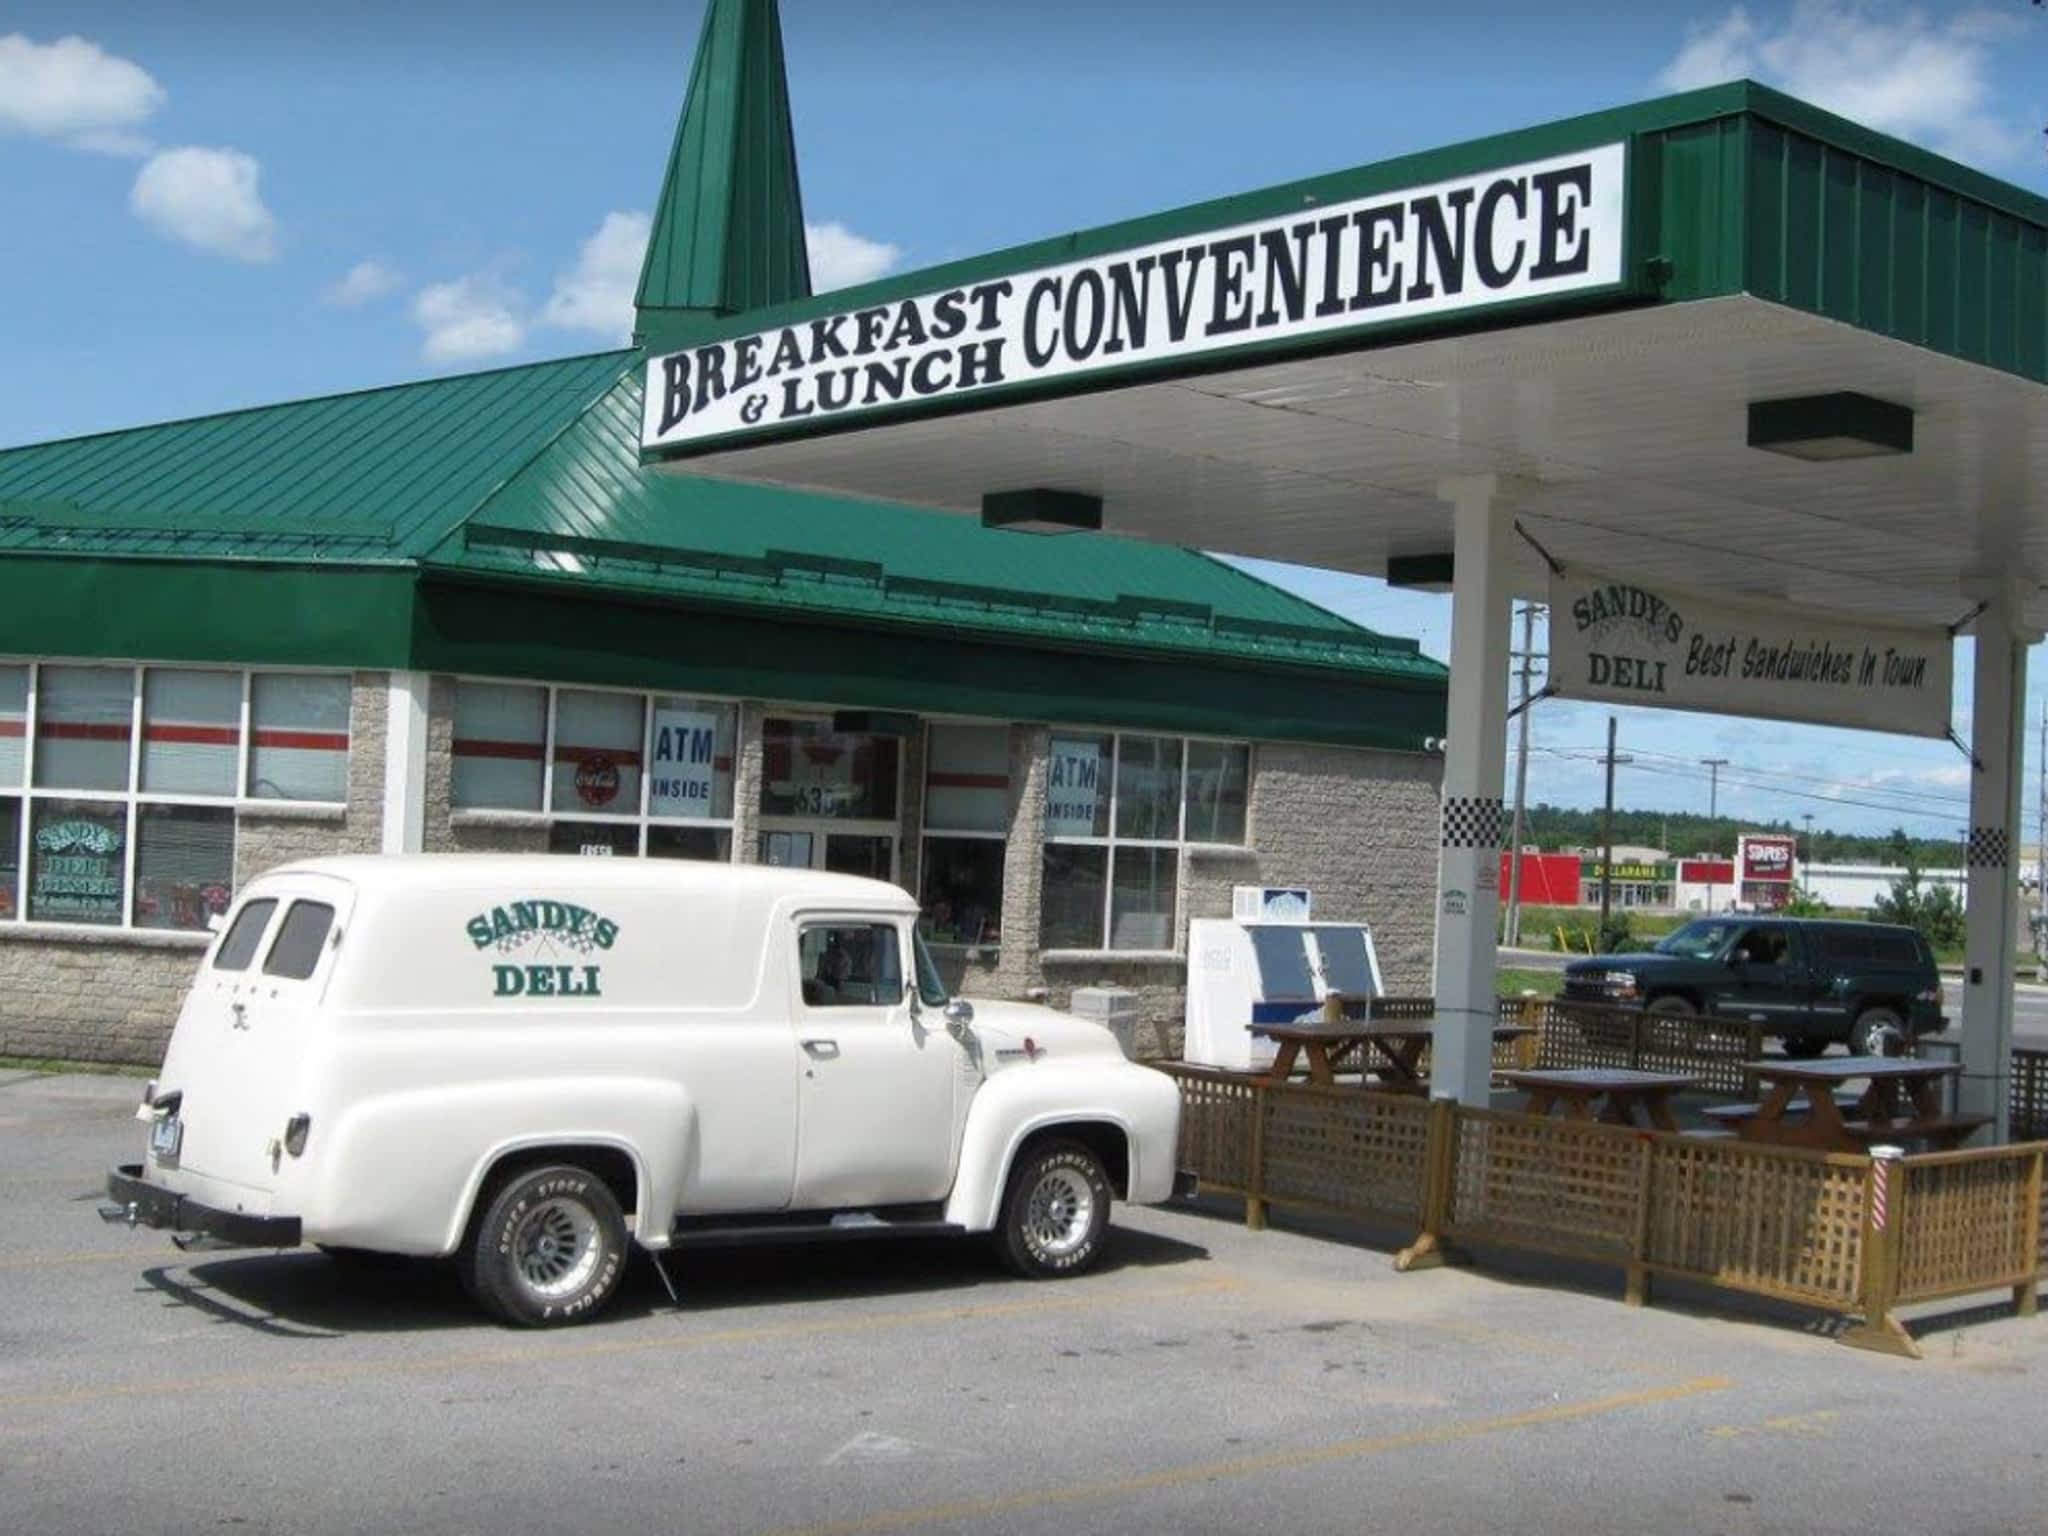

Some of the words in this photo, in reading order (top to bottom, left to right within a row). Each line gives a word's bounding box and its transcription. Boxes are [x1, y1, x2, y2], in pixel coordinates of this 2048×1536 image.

[1023, 165, 1591, 369] CONVENIENCE
[658, 280, 1013, 437] BREAKFAST
[740, 392, 769, 424] &
[779, 337, 1005, 418] LUNCH
[1572, 585, 1684, 644] SANDY'S
[1588, 653, 1667, 692] DELI
[1685, 634, 1737, 677] Best
[1741, 638, 1854, 685] Sandwiches
[1858, 645, 1875, 686] In
[1882, 648, 1926, 688] Town
[655, 726, 713, 764] ATM
[652, 778, 710, 800] INSIDE
[1050, 754, 1096, 789] ATM
[1047, 801, 1093, 820] INSIDE
[466, 899, 620, 951] SANDY'S
[492, 964, 602, 995] DELI
